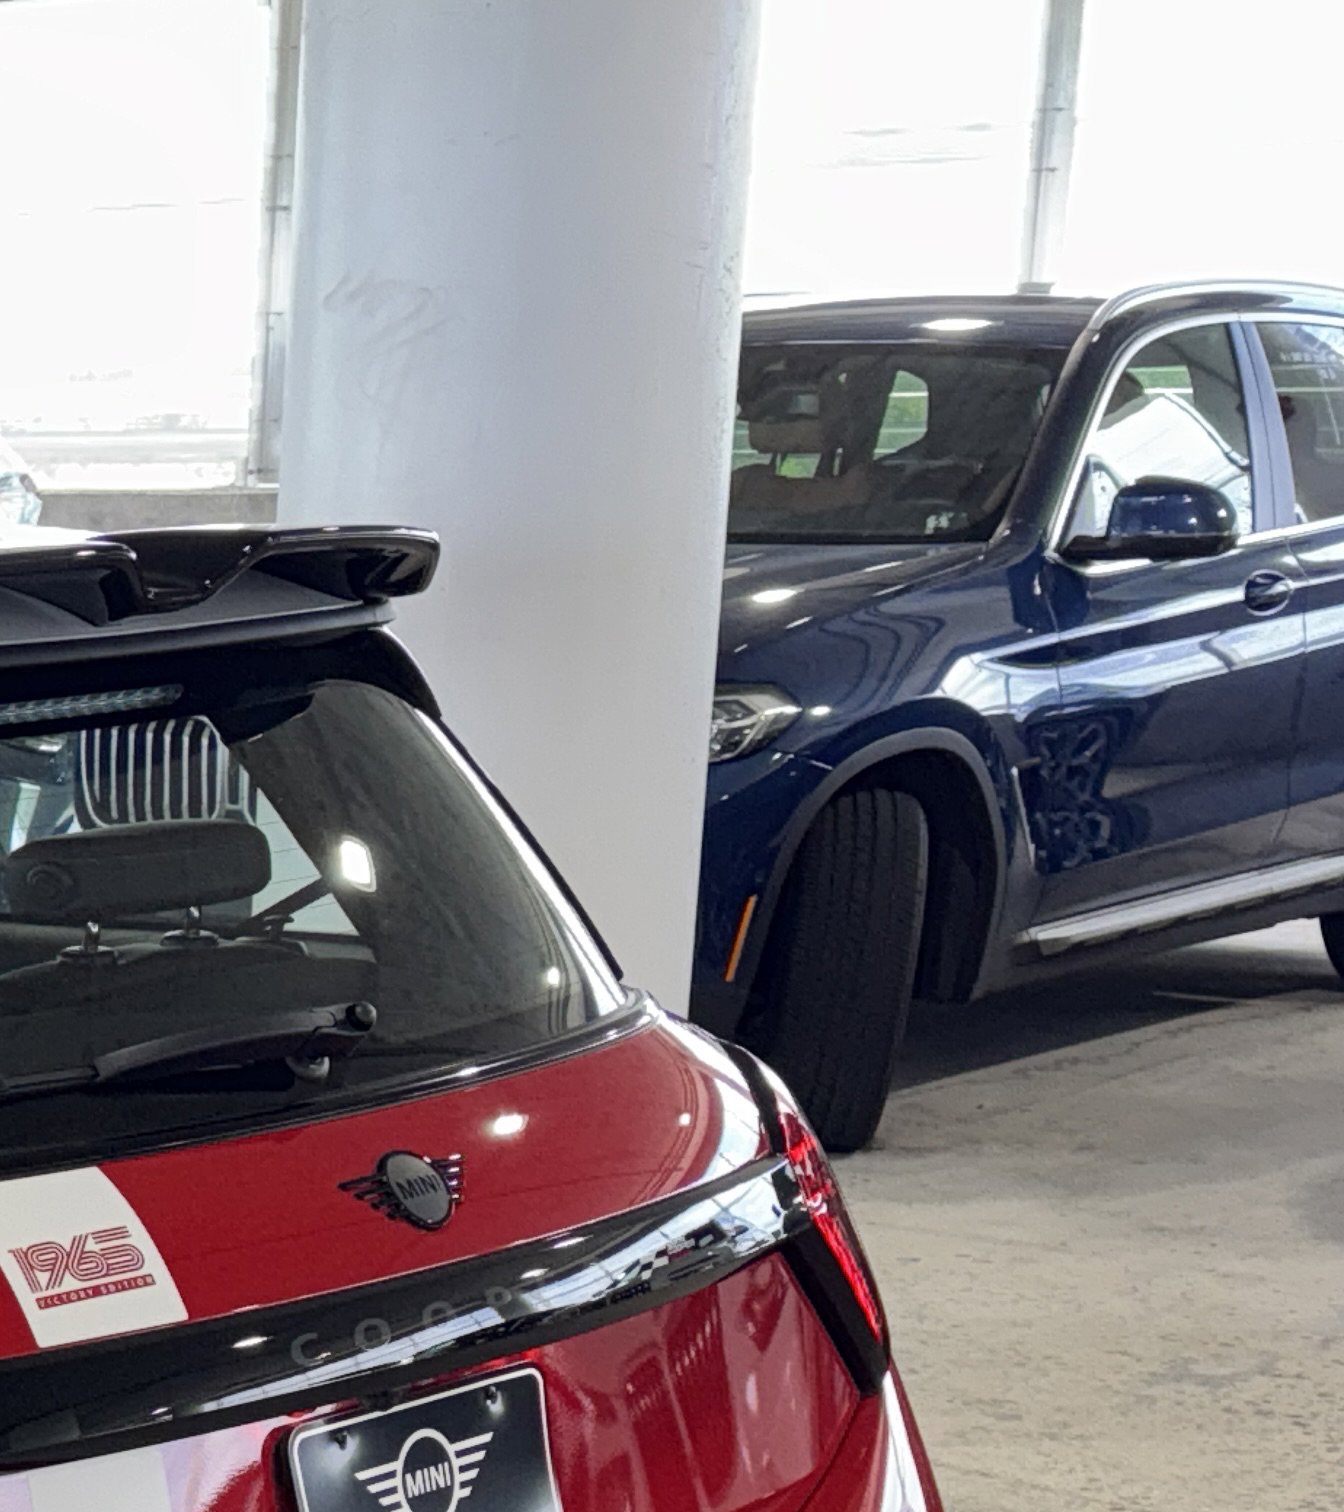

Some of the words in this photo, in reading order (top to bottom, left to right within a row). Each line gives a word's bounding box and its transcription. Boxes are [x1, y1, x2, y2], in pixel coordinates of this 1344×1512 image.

[395, 1173, 441, 1201] MINI
[8, 1225, 145, 1294] 1965
[38, 1288, 94, 1308] VICTORY
[100, 1275, 154, 1295] EDITION
[404, 1461, 452, 1498] MINI
